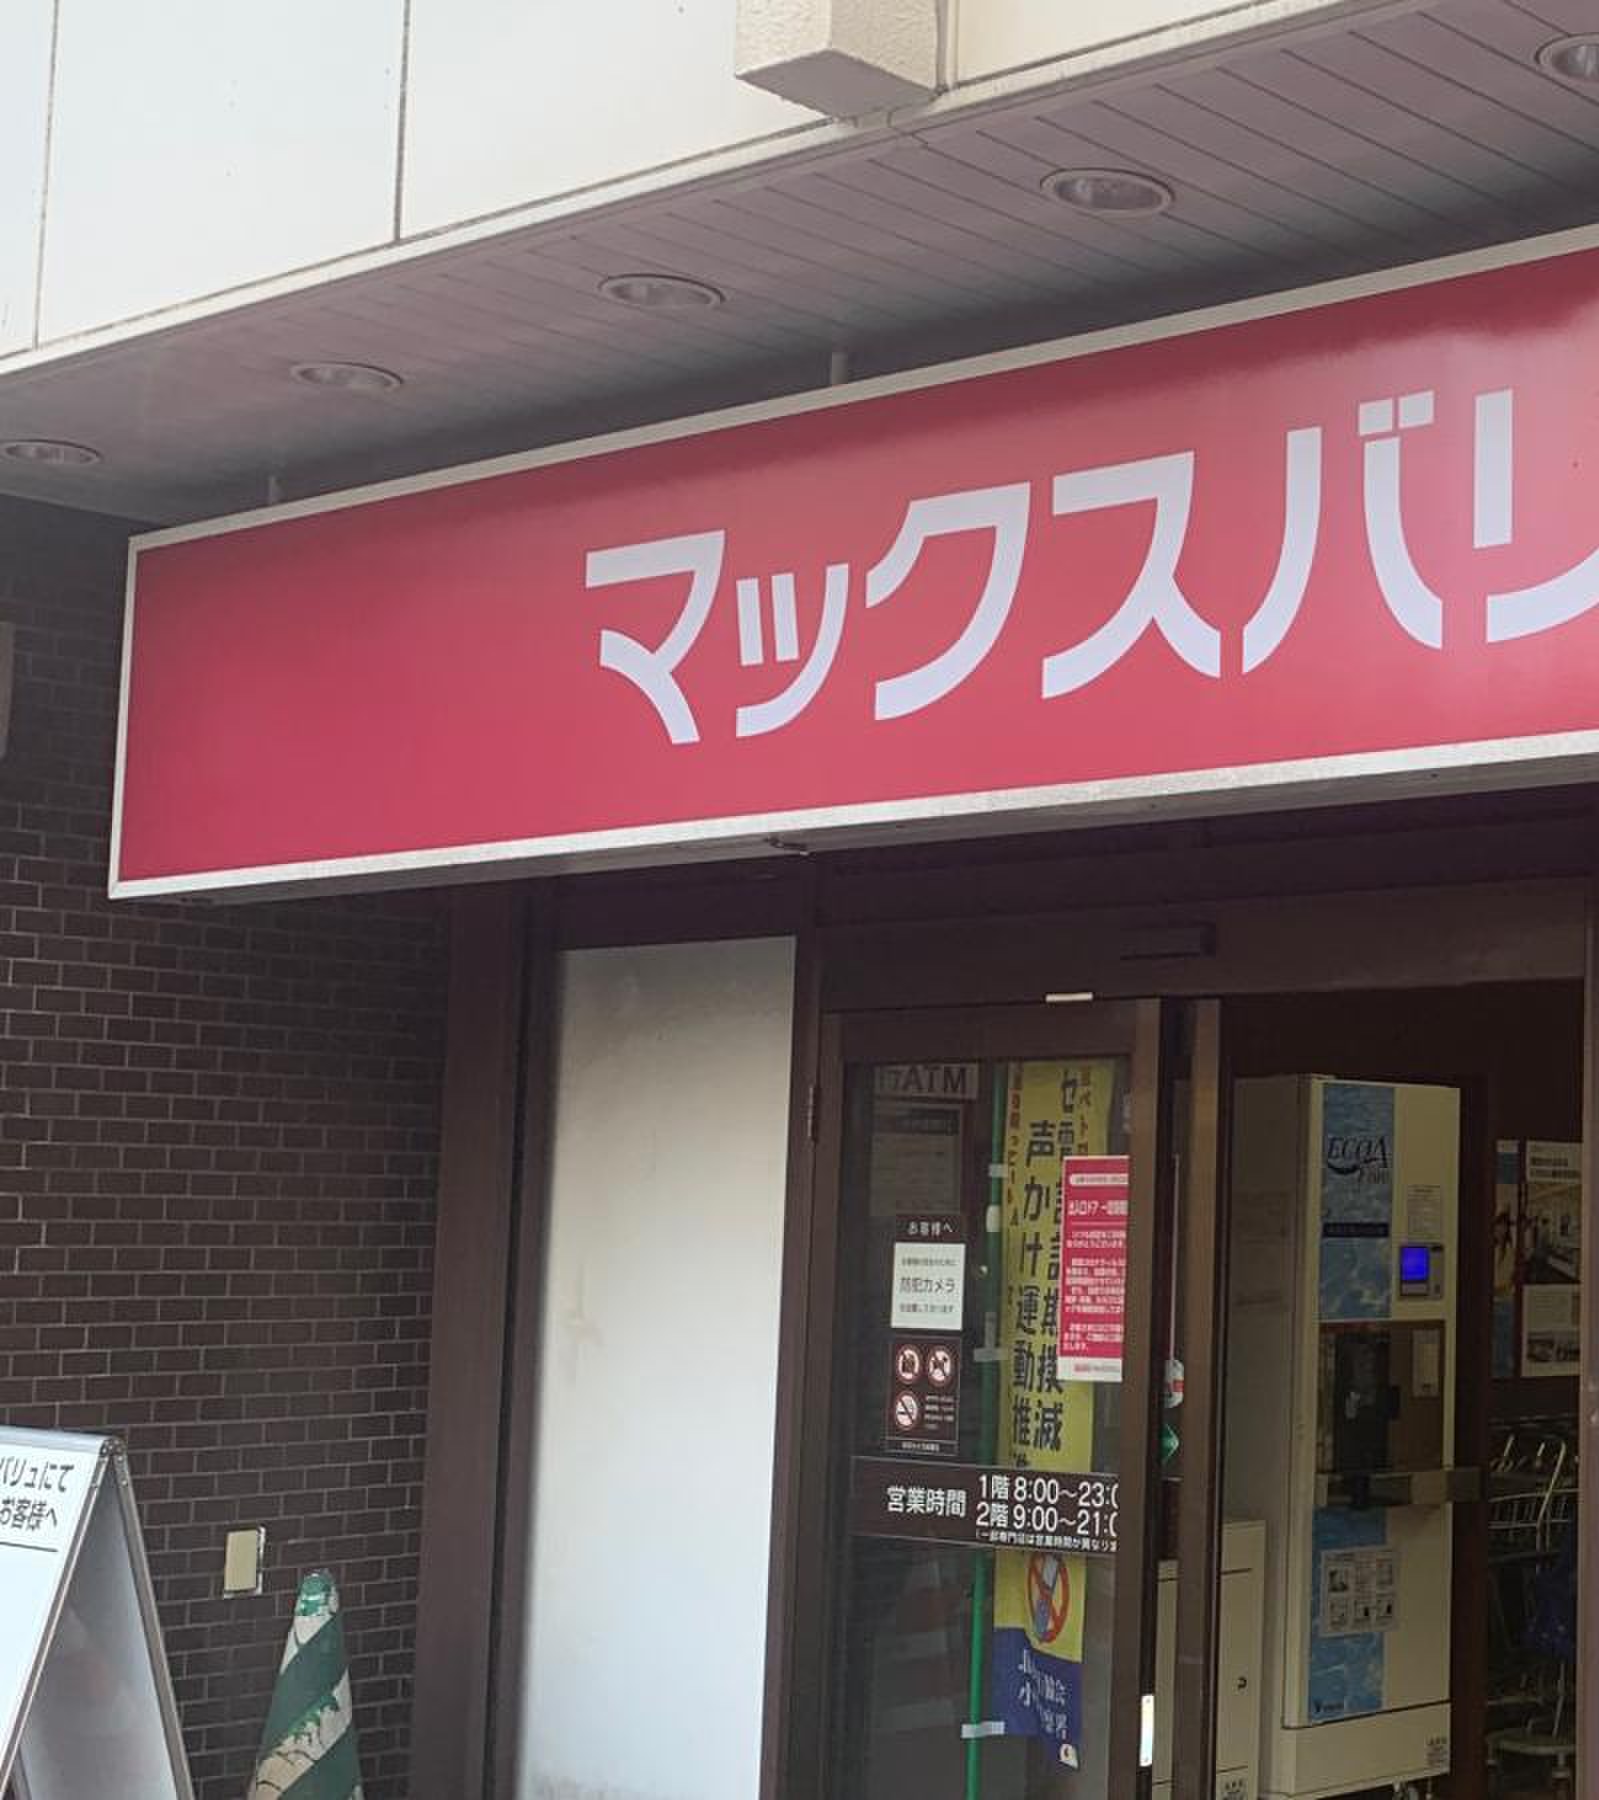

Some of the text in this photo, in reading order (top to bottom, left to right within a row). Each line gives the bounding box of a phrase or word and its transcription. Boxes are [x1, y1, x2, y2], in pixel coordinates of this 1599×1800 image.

[907, 1220, 953, 1236] お客様へ
[899, 1276, 956, 1294] 防犯カメラ
[978, 1474, 1010, 1500] 1階
[886, 1486, 967, 1518] 営業時間
[976, 1501, 1009, 1528] 2階
